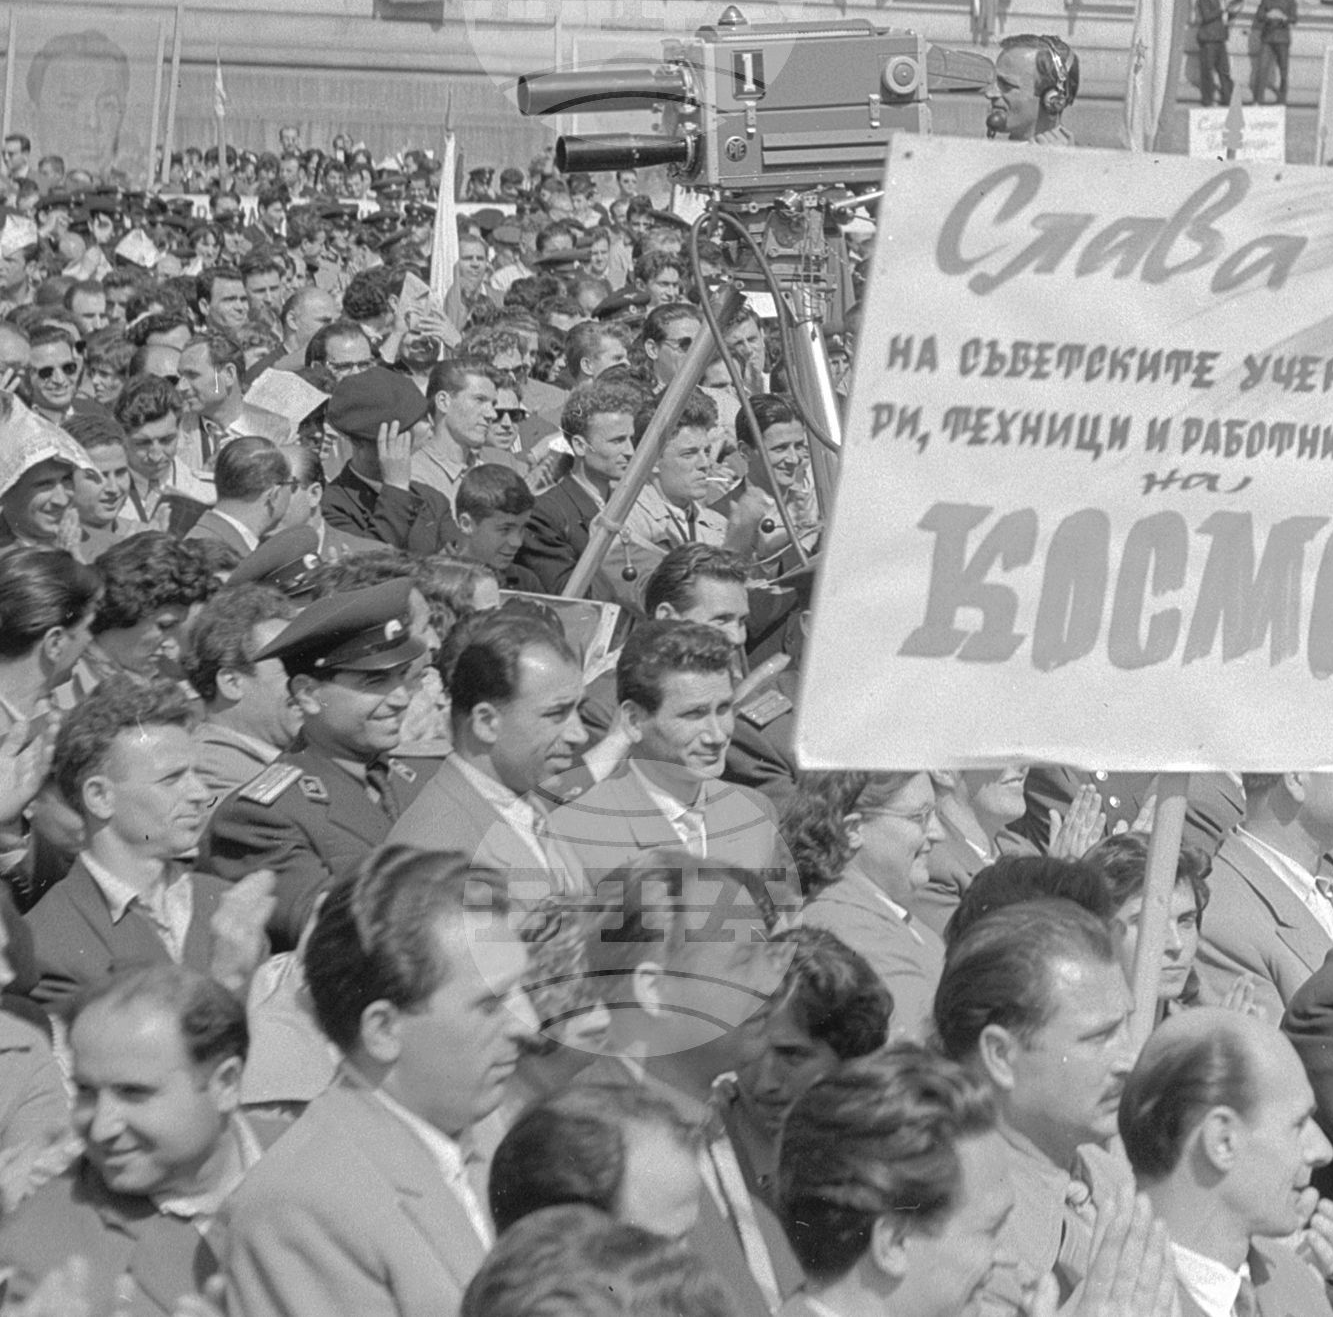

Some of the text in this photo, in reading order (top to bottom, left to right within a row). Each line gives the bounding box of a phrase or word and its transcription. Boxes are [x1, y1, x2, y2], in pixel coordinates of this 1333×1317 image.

[741, 53, 756, 92] 1
[934, 162, 1308, 295] Слава
[887, 334, 938, 375] НА
[959, 338, 1221, 389] СЪВЕТСКИТЕ
[870, 402, 932, 452] РИ,
[943, 405, 1130, 458] ТЕХНИЦИ
[1145, 417, 1168, 453] И
